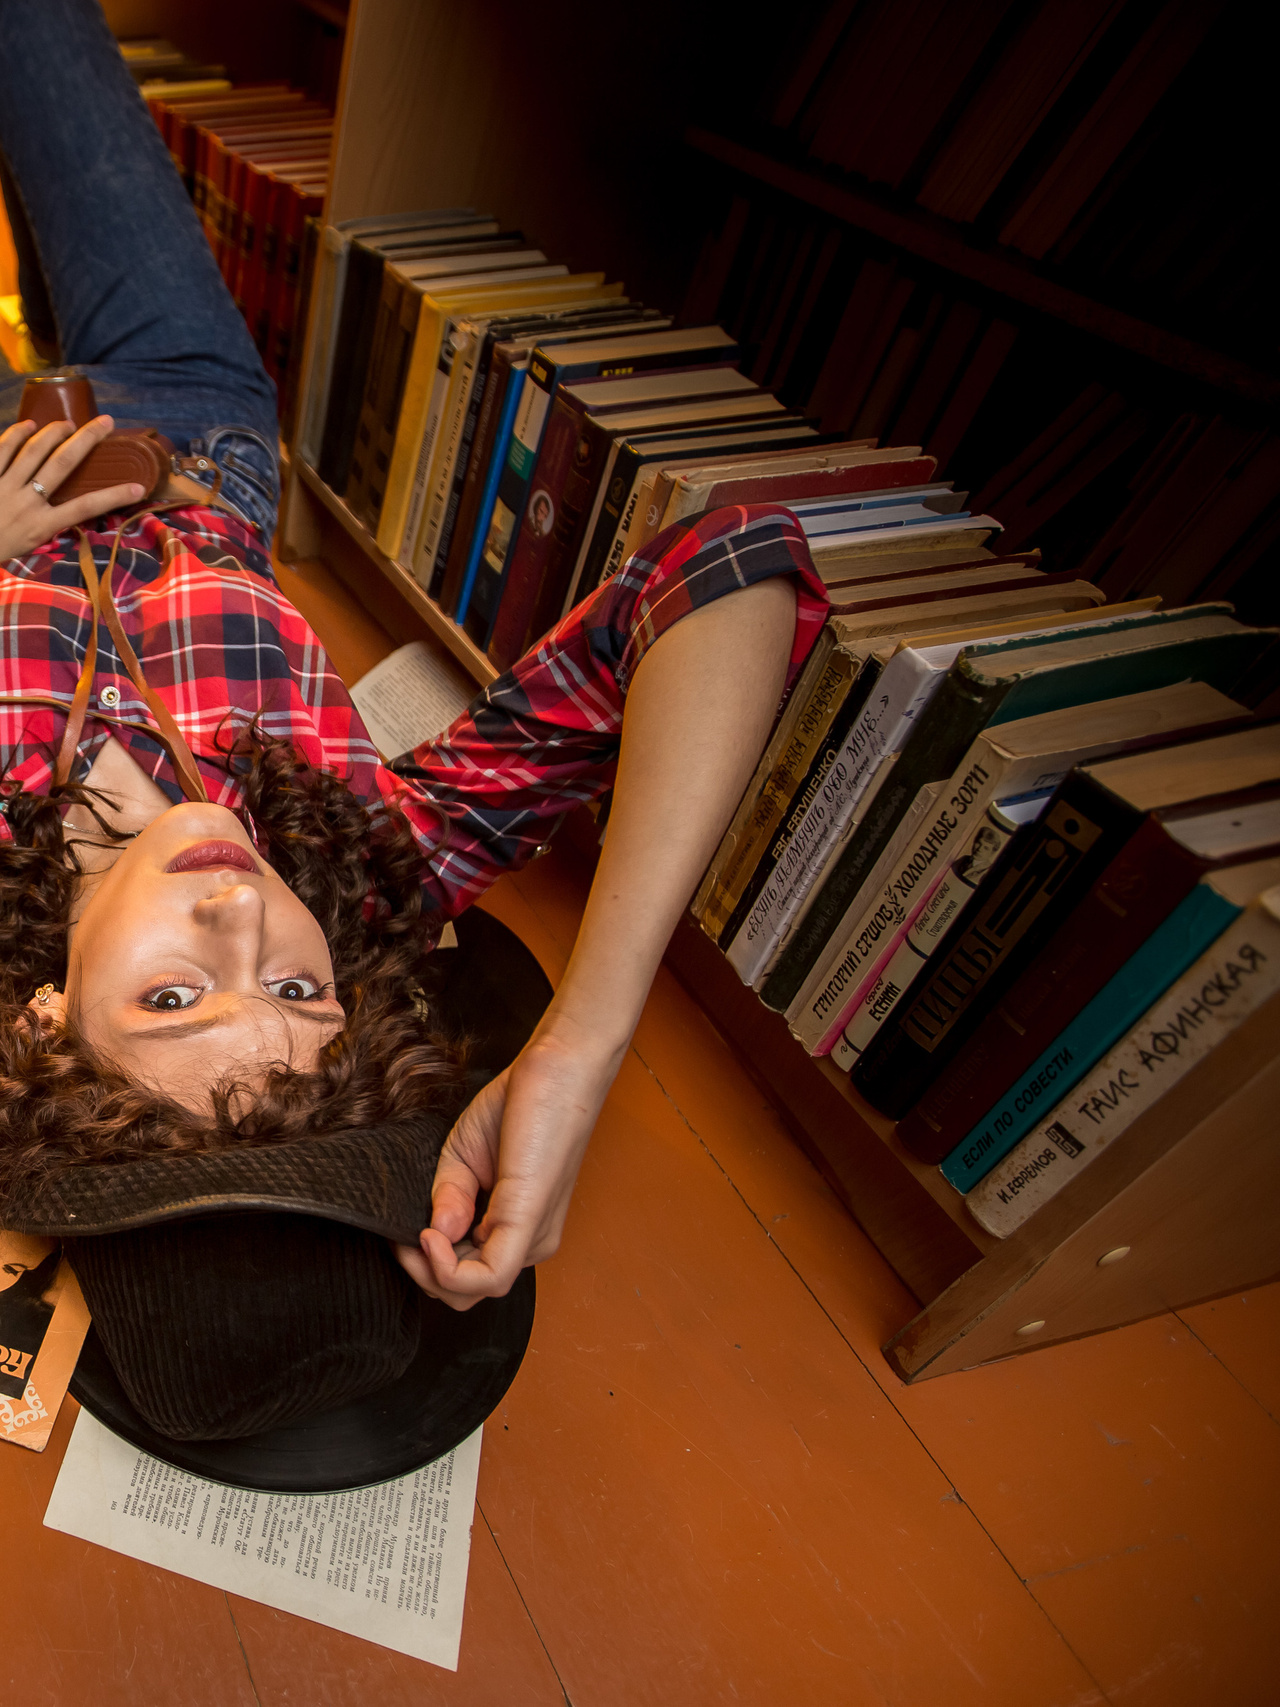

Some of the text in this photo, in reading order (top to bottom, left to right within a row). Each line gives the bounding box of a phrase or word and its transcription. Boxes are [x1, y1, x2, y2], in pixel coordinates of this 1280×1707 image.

[785, 746, 837, 833] ЕВТУШЕНКО
[776, 804, 825, 887] ПАМЯТЬ
[823, 762, 848, 805] ОБО
[813, 951, 859, 1020] ГРИГОРИЙ
[857, 906, 895, 959] ЕРШОВ
[894, 810, 958, 898] ХОЛОДНЫЕ
[951, 764, 990, 813] ЗОРИ
[915, 882, 950, 935] Анна Снегина
[927, 899, 957, 938] Стихотворения
[902, 926, 1003, 1042] ТИПЫ
[870, 981, 901, 1022] ЕСЕНИН
[1078, 1069, 1139, 1125] ТАИС
[1138, 942, 1268, 1073] АФИНСКАЯ
[963, 1047, 1074, 1170] ЕСЛИ ПО СОВЕСТИ
[123, 1457, 142, 1513] лозунгов всеми
[437, 1462, 447, 1492] Молодые
[130, 1486, 141, 1516] деятелей
[165, 1485, 173, 1504] чтобы
[172, 1487, 180, 1508] одним
[180, 1487, 190, 1508] Павел
[183, 1484, 197, 1526] реагировали
[282, 1506, 287, 1515] не
[391, 1490, 403, 1526] Александр
[409, 1491, 418, 1523] общества
[428, 1496, 433, 1504] на
[211, 1506, 225, 1544] Муромских
[264, 1513, 279, 1563] обязывающую
[277, 1519, 285, 1541] может
[294, 1513, 302, 1533] тайну.
[304, 1502, 320, 1568] тайного общества
[339, 1522, 349, 1556] переплете
[351, 1526, 356, 1535] он
[283, 1539, 289, 1548] до
[295, 1526, 307, 1574] повиноваться
[310, 1522, 324, 1579] короткой речью
[329, 1520, 341, 1565] недоумением
[346, 1538, 354, 1559] вынул
[350, 1490, 371, 1592] брату небольшим узелком
[372, 1528, 380, 1555] прошла
[386, 1534, 397, 1568] Муравьев
[414, 1541, 419, 1551] им
[421, 1545, 426, 1553] их
[344, 1562, 350, 1570] из
[376, 1575, 383, 1585] Но
[409, 1575, 414, 1583] не
[432, 1552, 442, 1603] существенный
[365, 1589, 370, 1598] не
